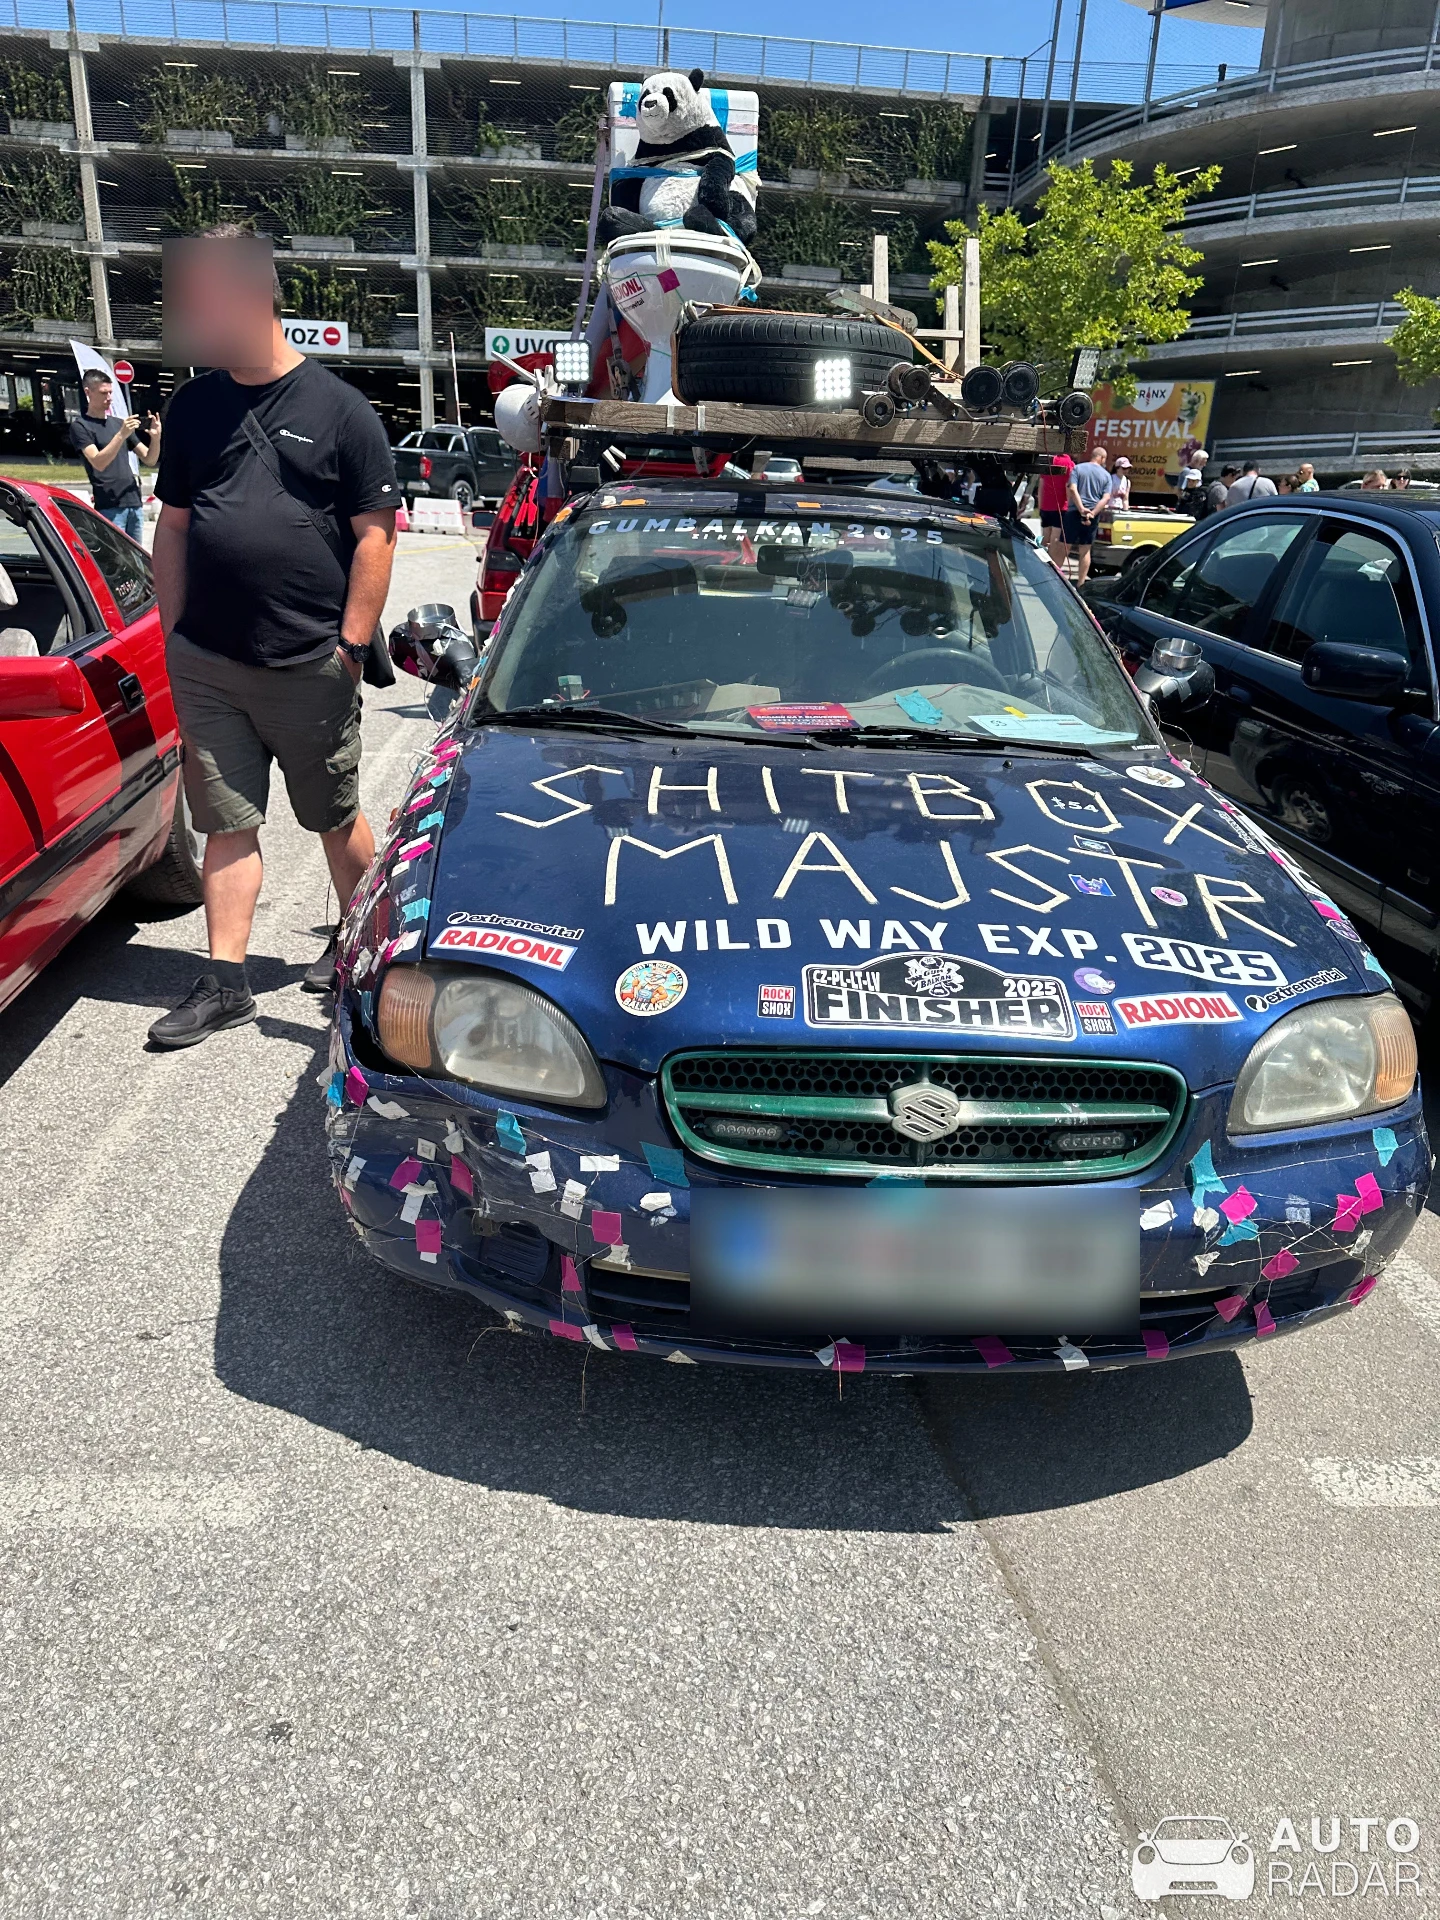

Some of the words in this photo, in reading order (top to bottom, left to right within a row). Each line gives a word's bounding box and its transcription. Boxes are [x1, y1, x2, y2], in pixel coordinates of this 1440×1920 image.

[1094, 418, 1195, 440] FESTIVAL
[588, 517, 831, 537] GUMBALKAN
[846, 524, 945, 546] 2025
[604, 831, 1298, 948] MAJSTR
[467, 913, 584, 941] extremevital
[439, 929, 564, 967] RADIONL
[635, 917, 792, 955] WILD
[818, 919, 949, 952] WAY
[977, 923, 1118, 964] EXP.
[1132, 936, 1279, 982] 2025
[763, 988, 791, 1000] ROCK
[1003, 979, 1058, 998] 2025
[1265, 967, 1348, 1006] extremevital
[762, 1001, 791, 1016] SHOX
[816, 984, 1067, 1032] FINISHER
[1078, 1004, 1108, 1016] ROCK
[1117, 997, 1240, 1025] RADIONL
[1083, 1018, 1114, 1032] SHOX
